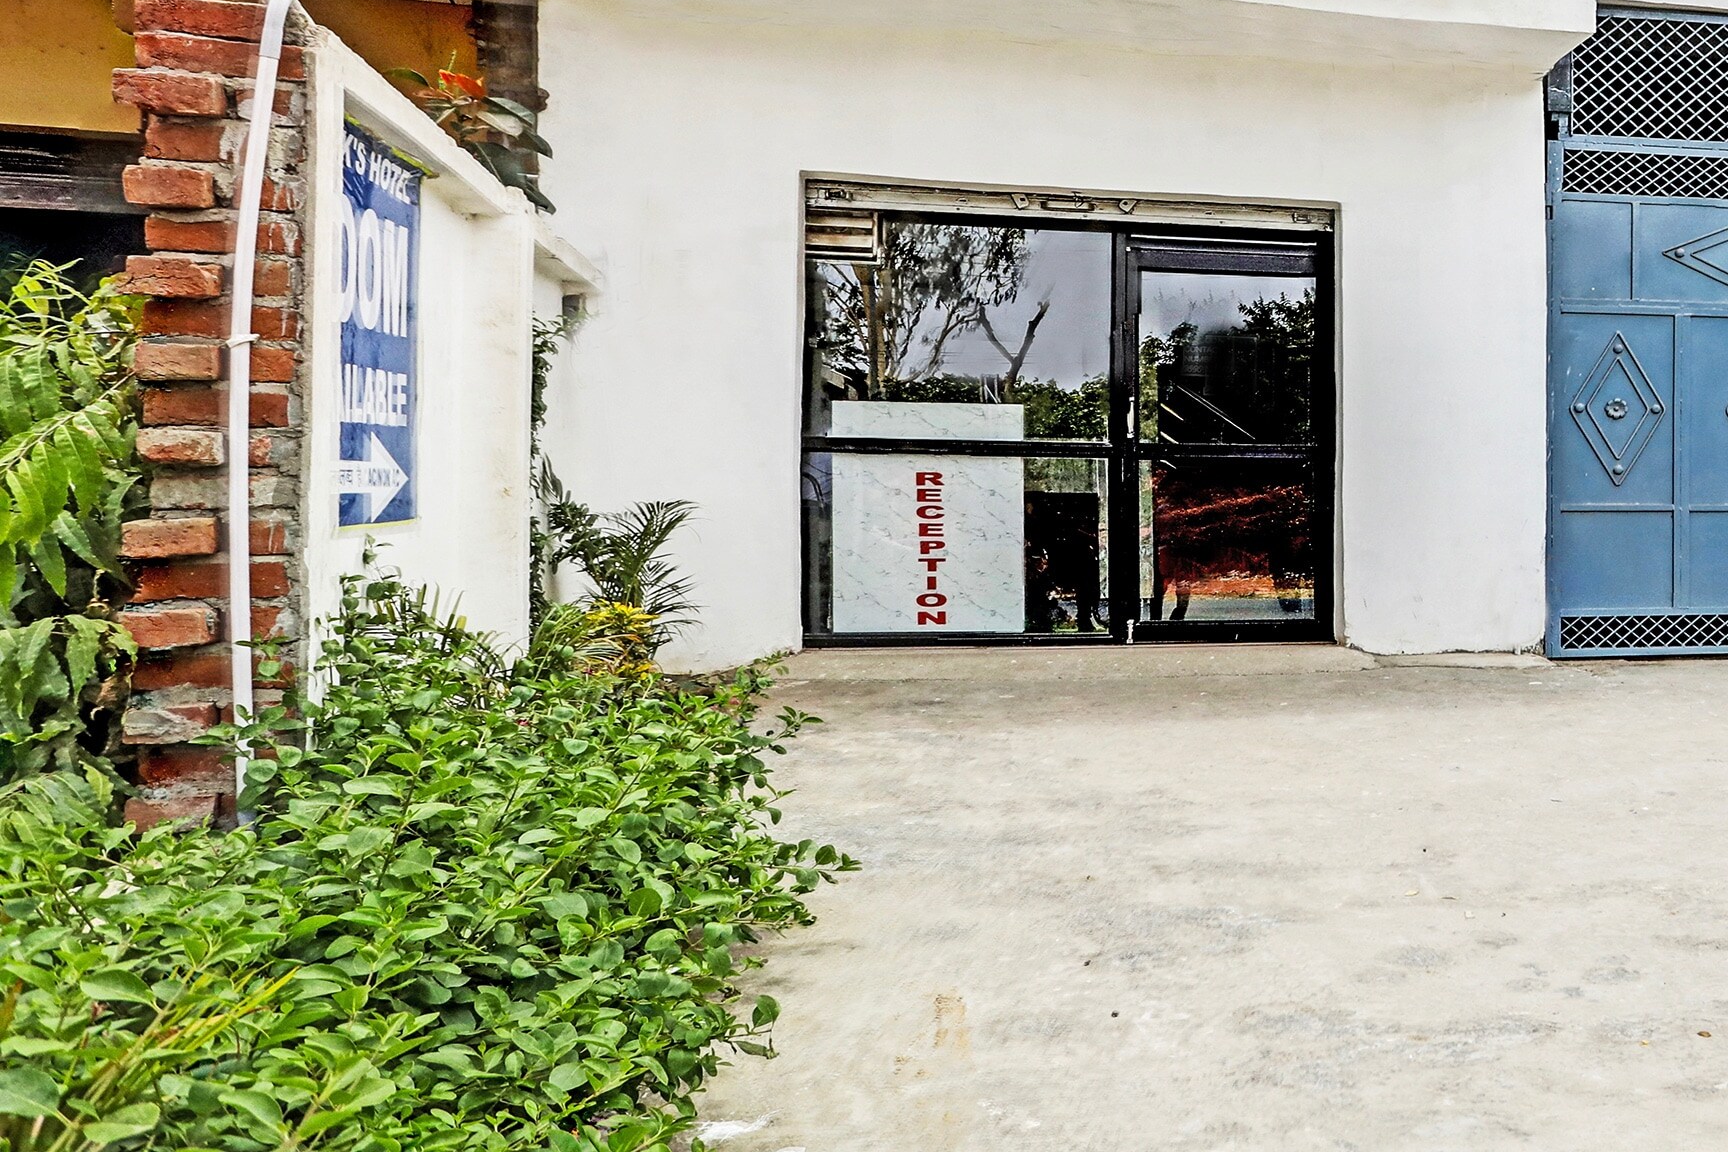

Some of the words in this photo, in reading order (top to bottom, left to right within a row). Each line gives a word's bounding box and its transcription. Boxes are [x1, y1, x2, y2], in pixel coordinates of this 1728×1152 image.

[343, 133, 367, 176] K'S
[369, 150, 412, 206] HOTEL
[338, 195, 409, 338] OOM
[338, 363, 408, 427] ILABLE
[915, 471, 948, 626] RECEPTION
